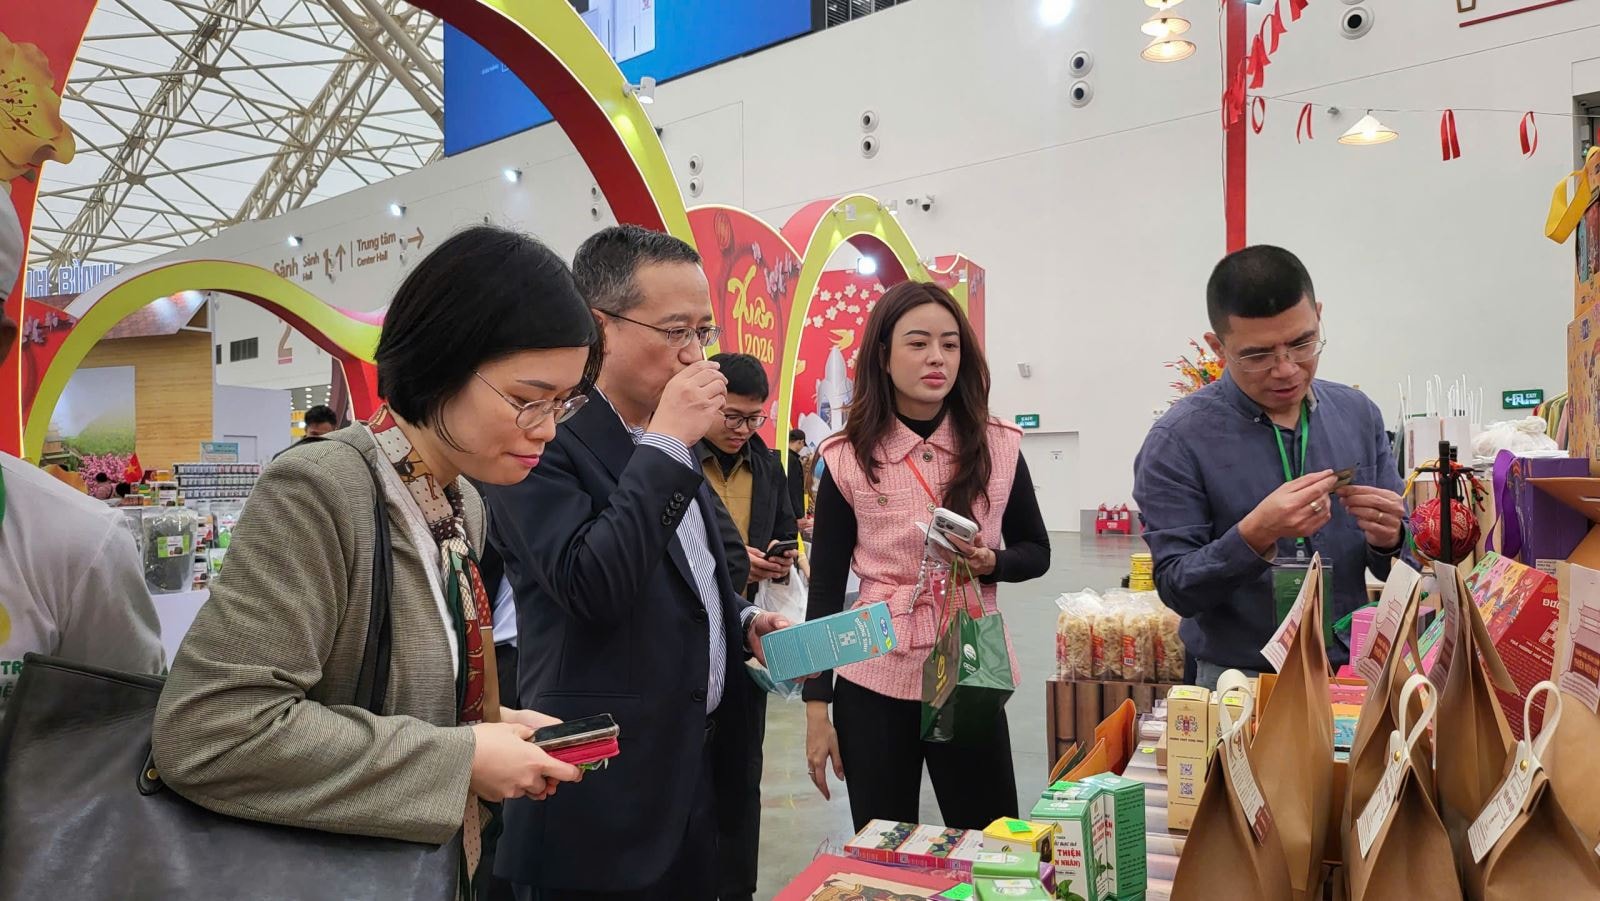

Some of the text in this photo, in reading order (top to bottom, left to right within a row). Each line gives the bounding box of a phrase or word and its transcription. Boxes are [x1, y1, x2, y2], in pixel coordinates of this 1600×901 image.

[357, 232, 396, 252] Trung tâm
[357, 250, 388, 267] Center Hall
[58, 258, 116, 295] BÌNH
[303, 270, 313, 281] Hall
[727, 264, 774, 354] Xuân
[744, 333, 775, 364] 2026
[0, 660, 23, 675] TR
[1057, 847, 1081, 858] THIỆN
